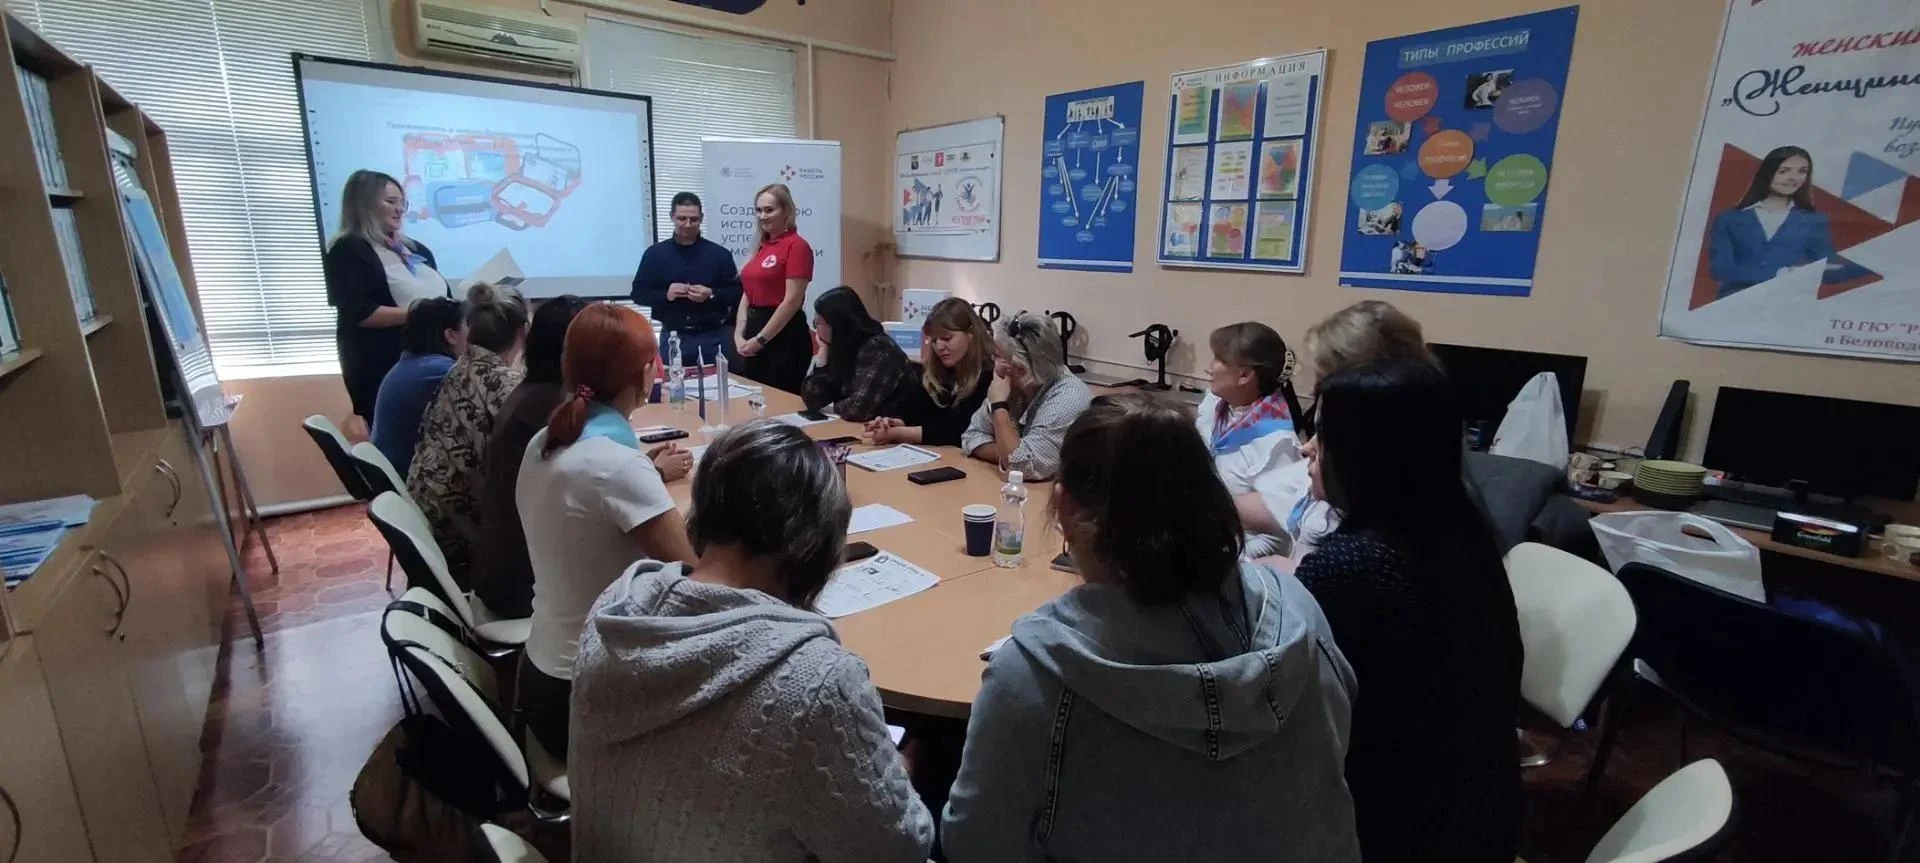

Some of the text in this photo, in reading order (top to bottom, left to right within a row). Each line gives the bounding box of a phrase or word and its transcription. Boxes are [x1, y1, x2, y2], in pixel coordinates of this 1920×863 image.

[1404, 30, 1530, 62] ТИПЫ ПРОФЕССИЙ
[1215, 62, 1307, 82] ИНФОРМАЦИЯ
[1889, 116, 1920, 138] Пу
[720, 204, 756, 218] Созд
[721, 220, 753, 229] исто
[721, 233, 752, 245] успе
[1830, 319, 1854, 331] ТО
[1858, 321, 1895, 333] ГКУ
